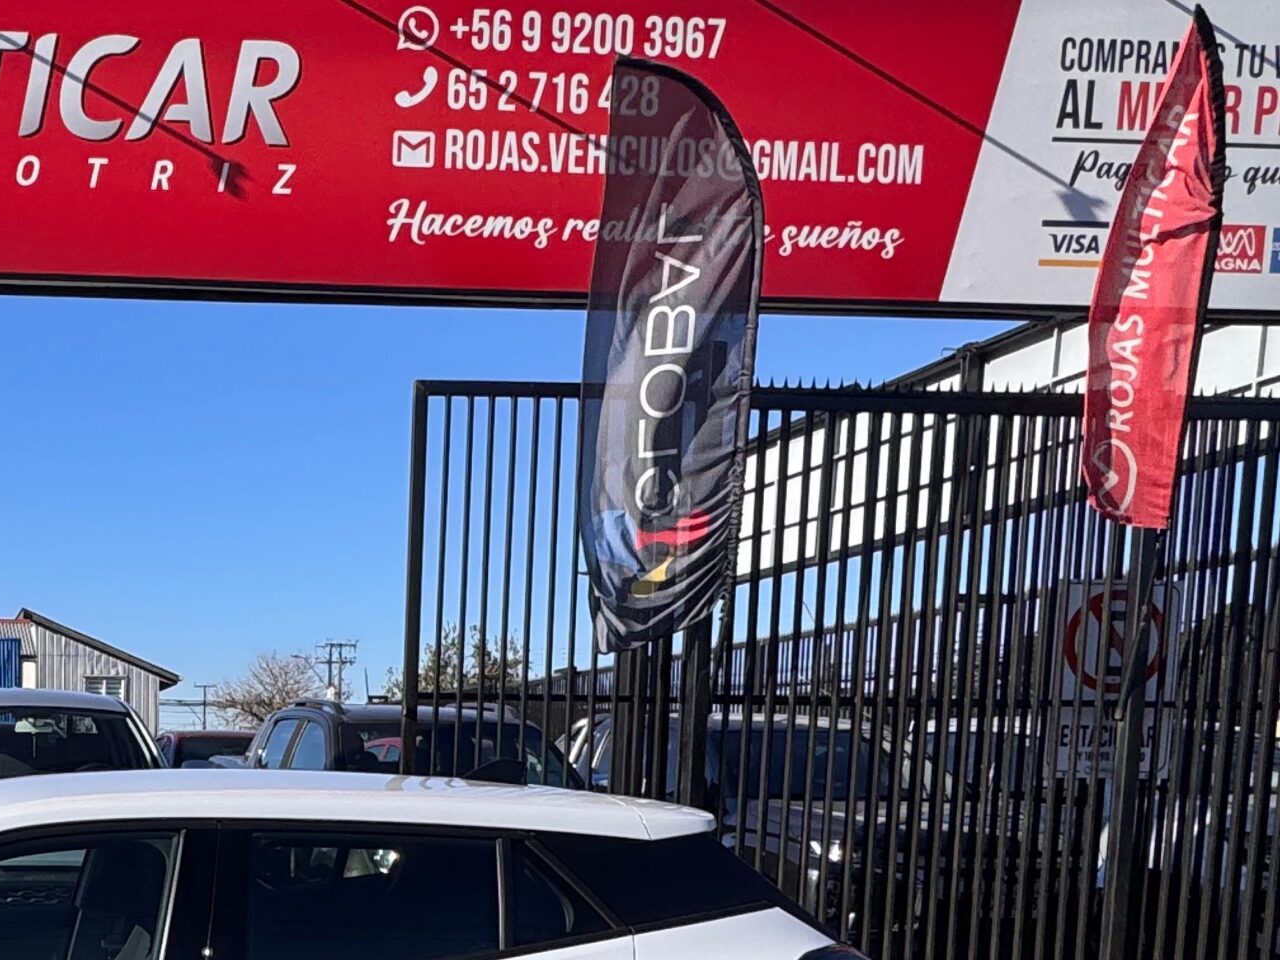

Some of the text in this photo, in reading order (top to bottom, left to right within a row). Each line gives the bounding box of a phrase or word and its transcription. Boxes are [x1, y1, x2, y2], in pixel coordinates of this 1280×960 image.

[450, 8, 727, 59] +56 9 9200 3967
[1234, 44, 1267, 79] TU
[447, 68, 488, 111] 65
[497, 70, 518, 112] 2
[528, 72, 589, 115] 716
[1056, 79, 1103, 129] AL
[387, 198, 556, 248] Hacemos
[779, 220, 904, 259] sueños
[1051, 233, 1100, 254] VISA
[1109, 314, 1144, 433] ROJAS
